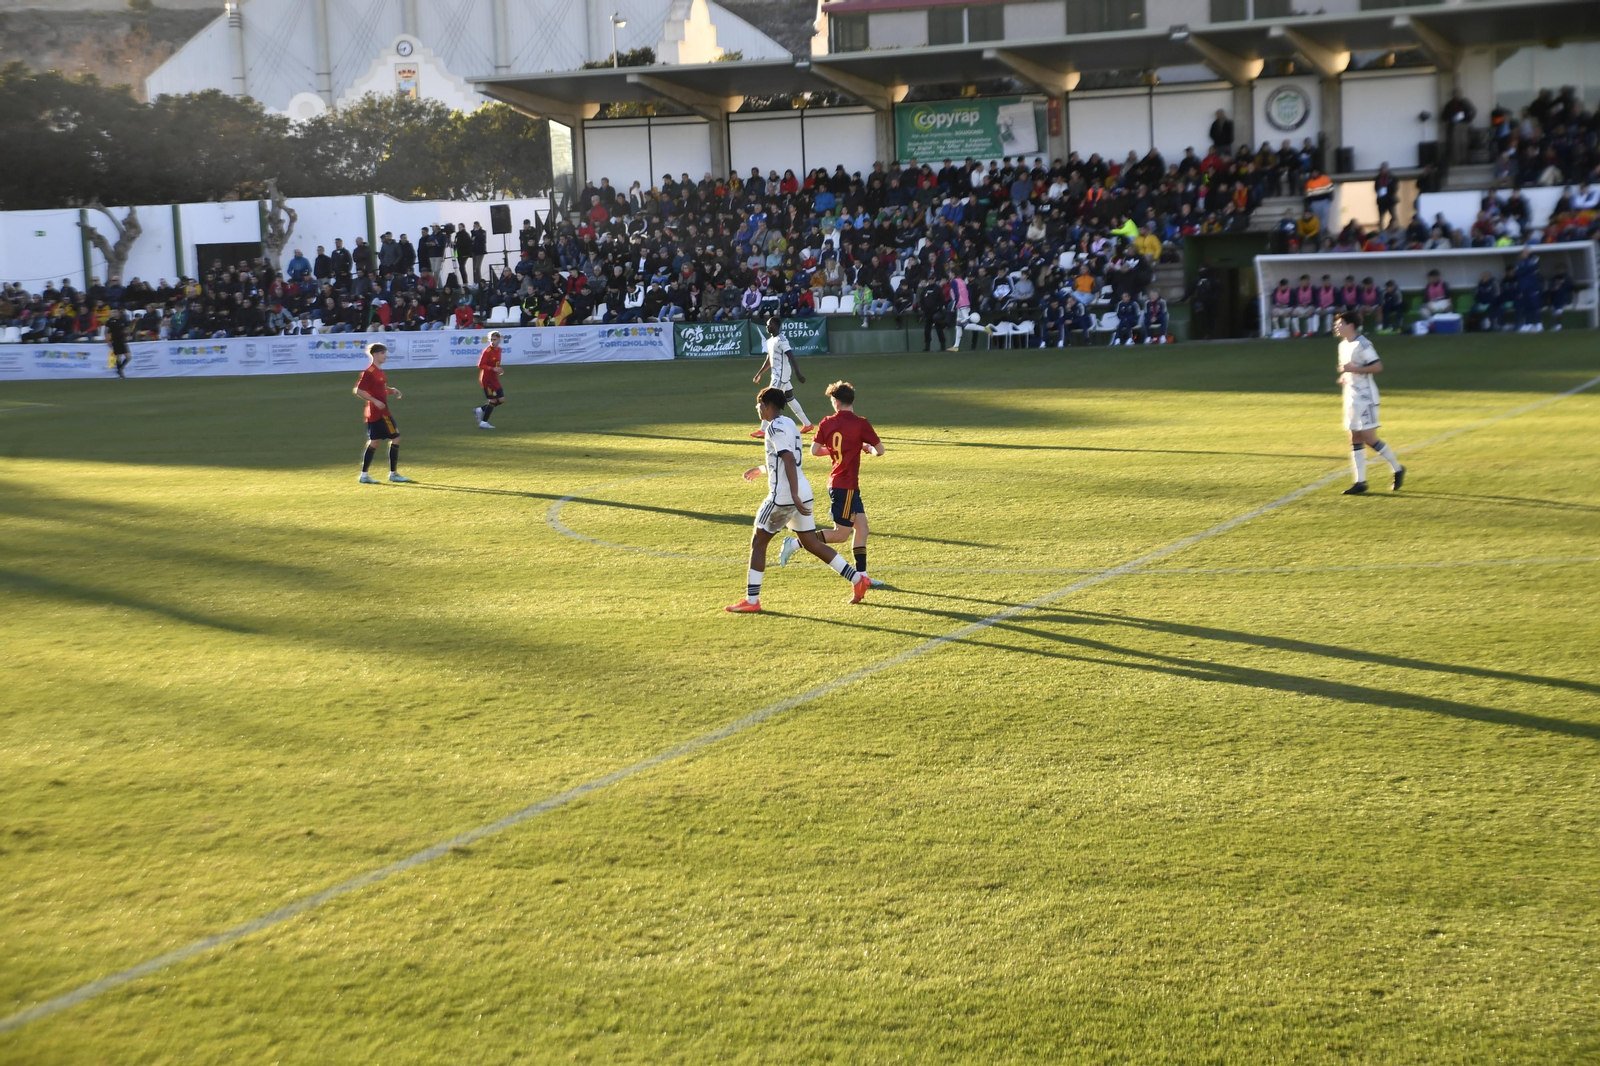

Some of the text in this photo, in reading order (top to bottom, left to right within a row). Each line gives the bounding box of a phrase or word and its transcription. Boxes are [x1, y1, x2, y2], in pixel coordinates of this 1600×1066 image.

[919, 111, 980, 129] copyrap
[710, 324, 737, 332] FRUTAS
[781, 322, 808, 330] HOTEL
[788, 330, 820, 338] ESPADA
[599, 340, 664, 349] TORREMOLINOS
[450, 347, 512, 355] TORREMOS
[170, 357, 229, 365] TORREMOLINOS
[795, 435, 803, 467] 5
[832, 431, 843, 464] 9
